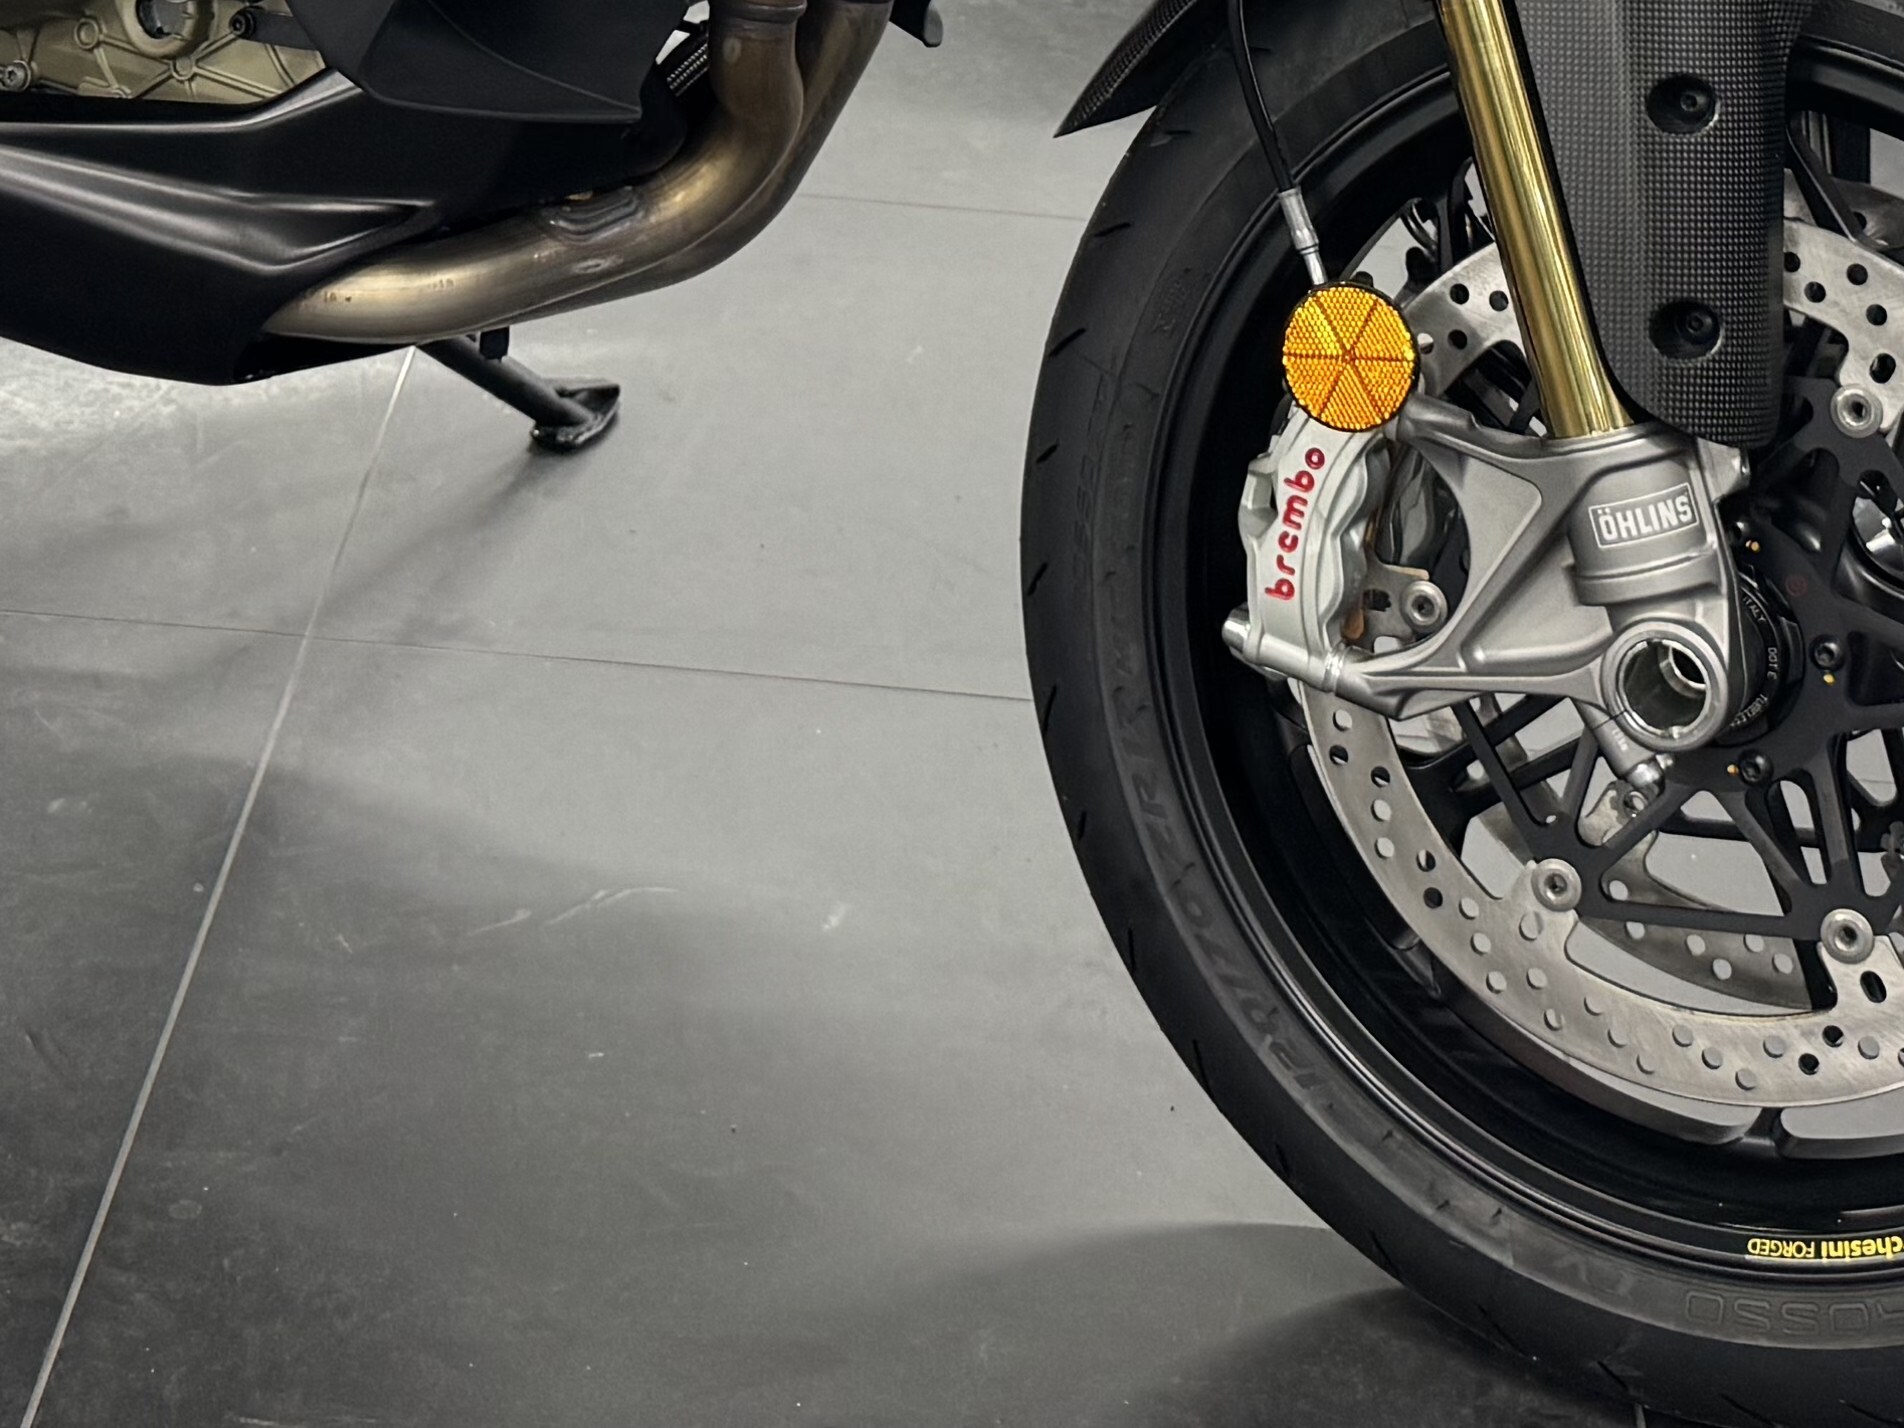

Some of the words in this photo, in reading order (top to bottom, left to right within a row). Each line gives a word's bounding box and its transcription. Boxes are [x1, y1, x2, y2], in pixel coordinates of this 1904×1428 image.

[1264, 446, 1326, 603] brembo
[1596, 494, 1696, 543] ÖHLINS
[1743, 596, 1767, 623] ITALY
[1747, 1238, 1817, 1260] FORGED
